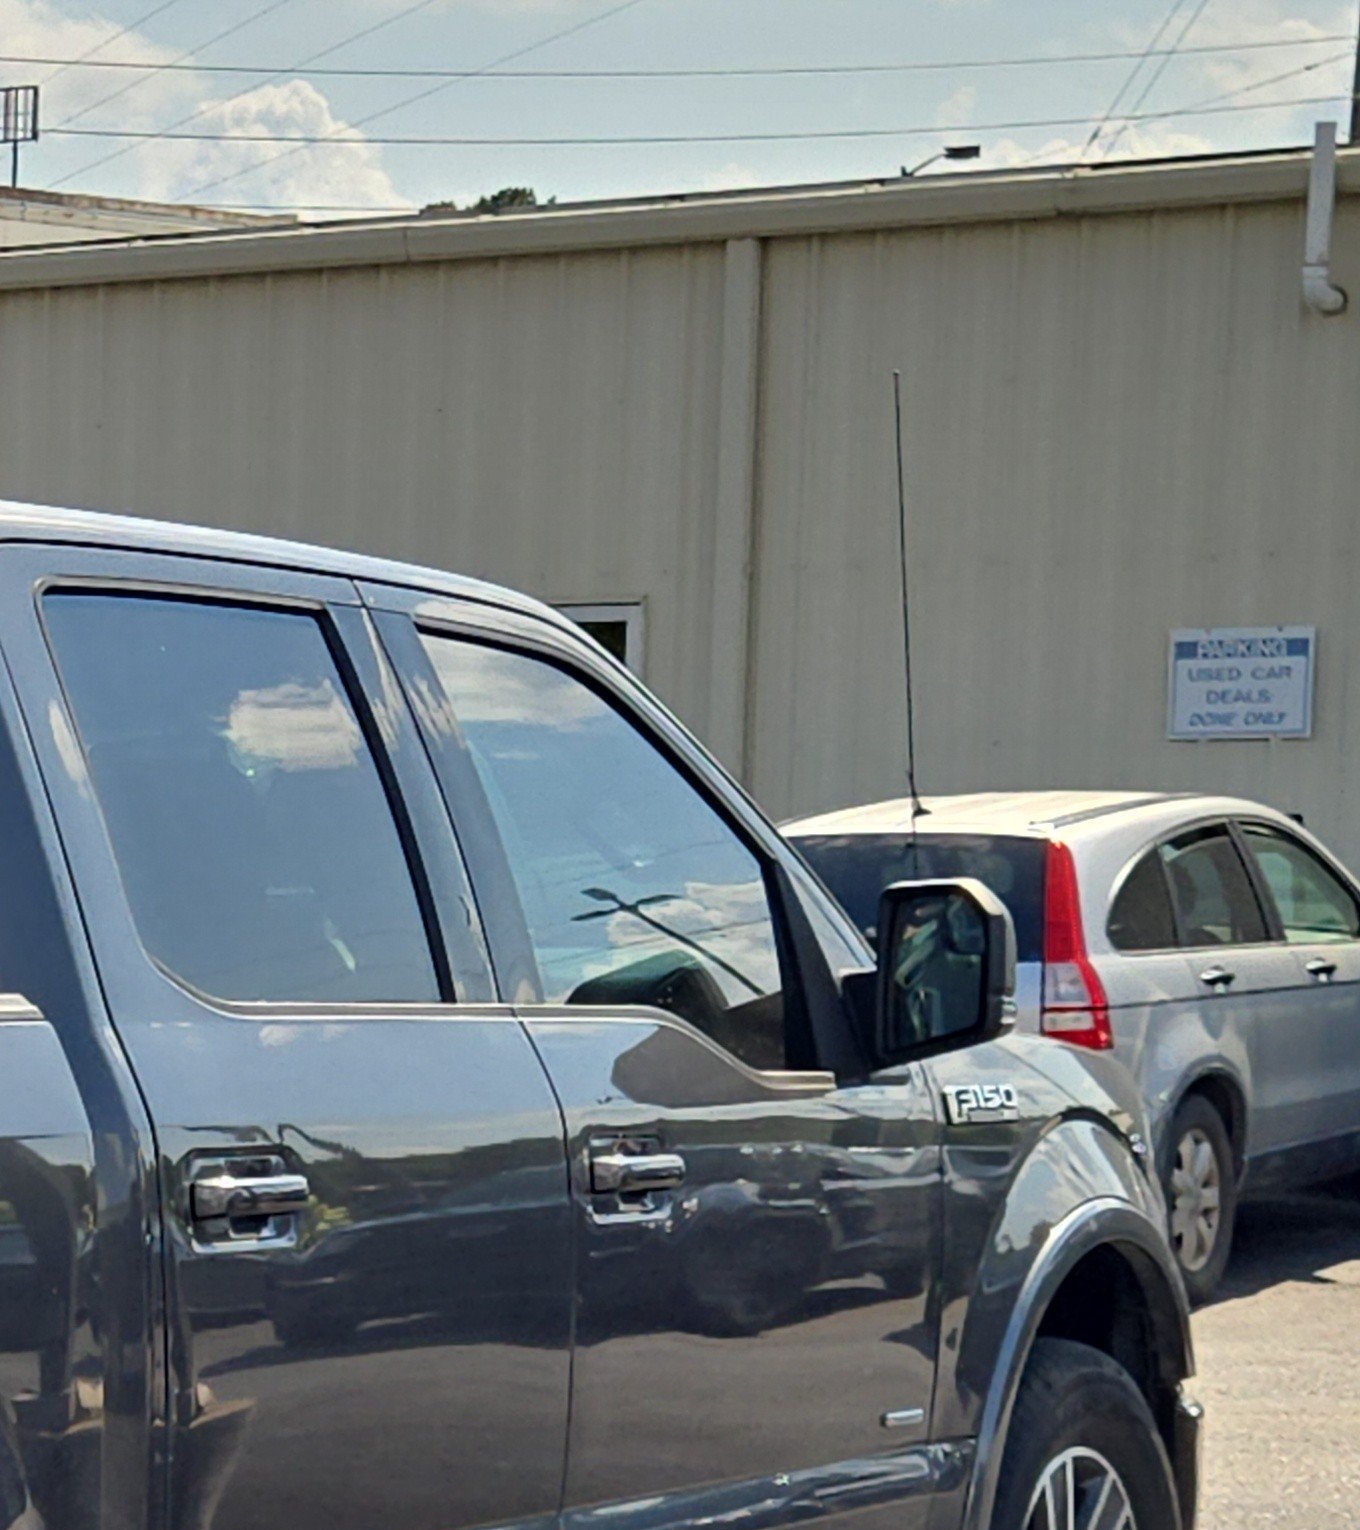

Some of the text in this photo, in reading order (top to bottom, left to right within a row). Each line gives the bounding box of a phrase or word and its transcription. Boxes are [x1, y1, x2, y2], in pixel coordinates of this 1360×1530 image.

[1188, 665, 1292, 683] USED CAR
[1206, 688, 1272, 705] DEALS
[1243, 710, 1287, 727] ONLY
[942, 1083, 1018, 1124] F150
